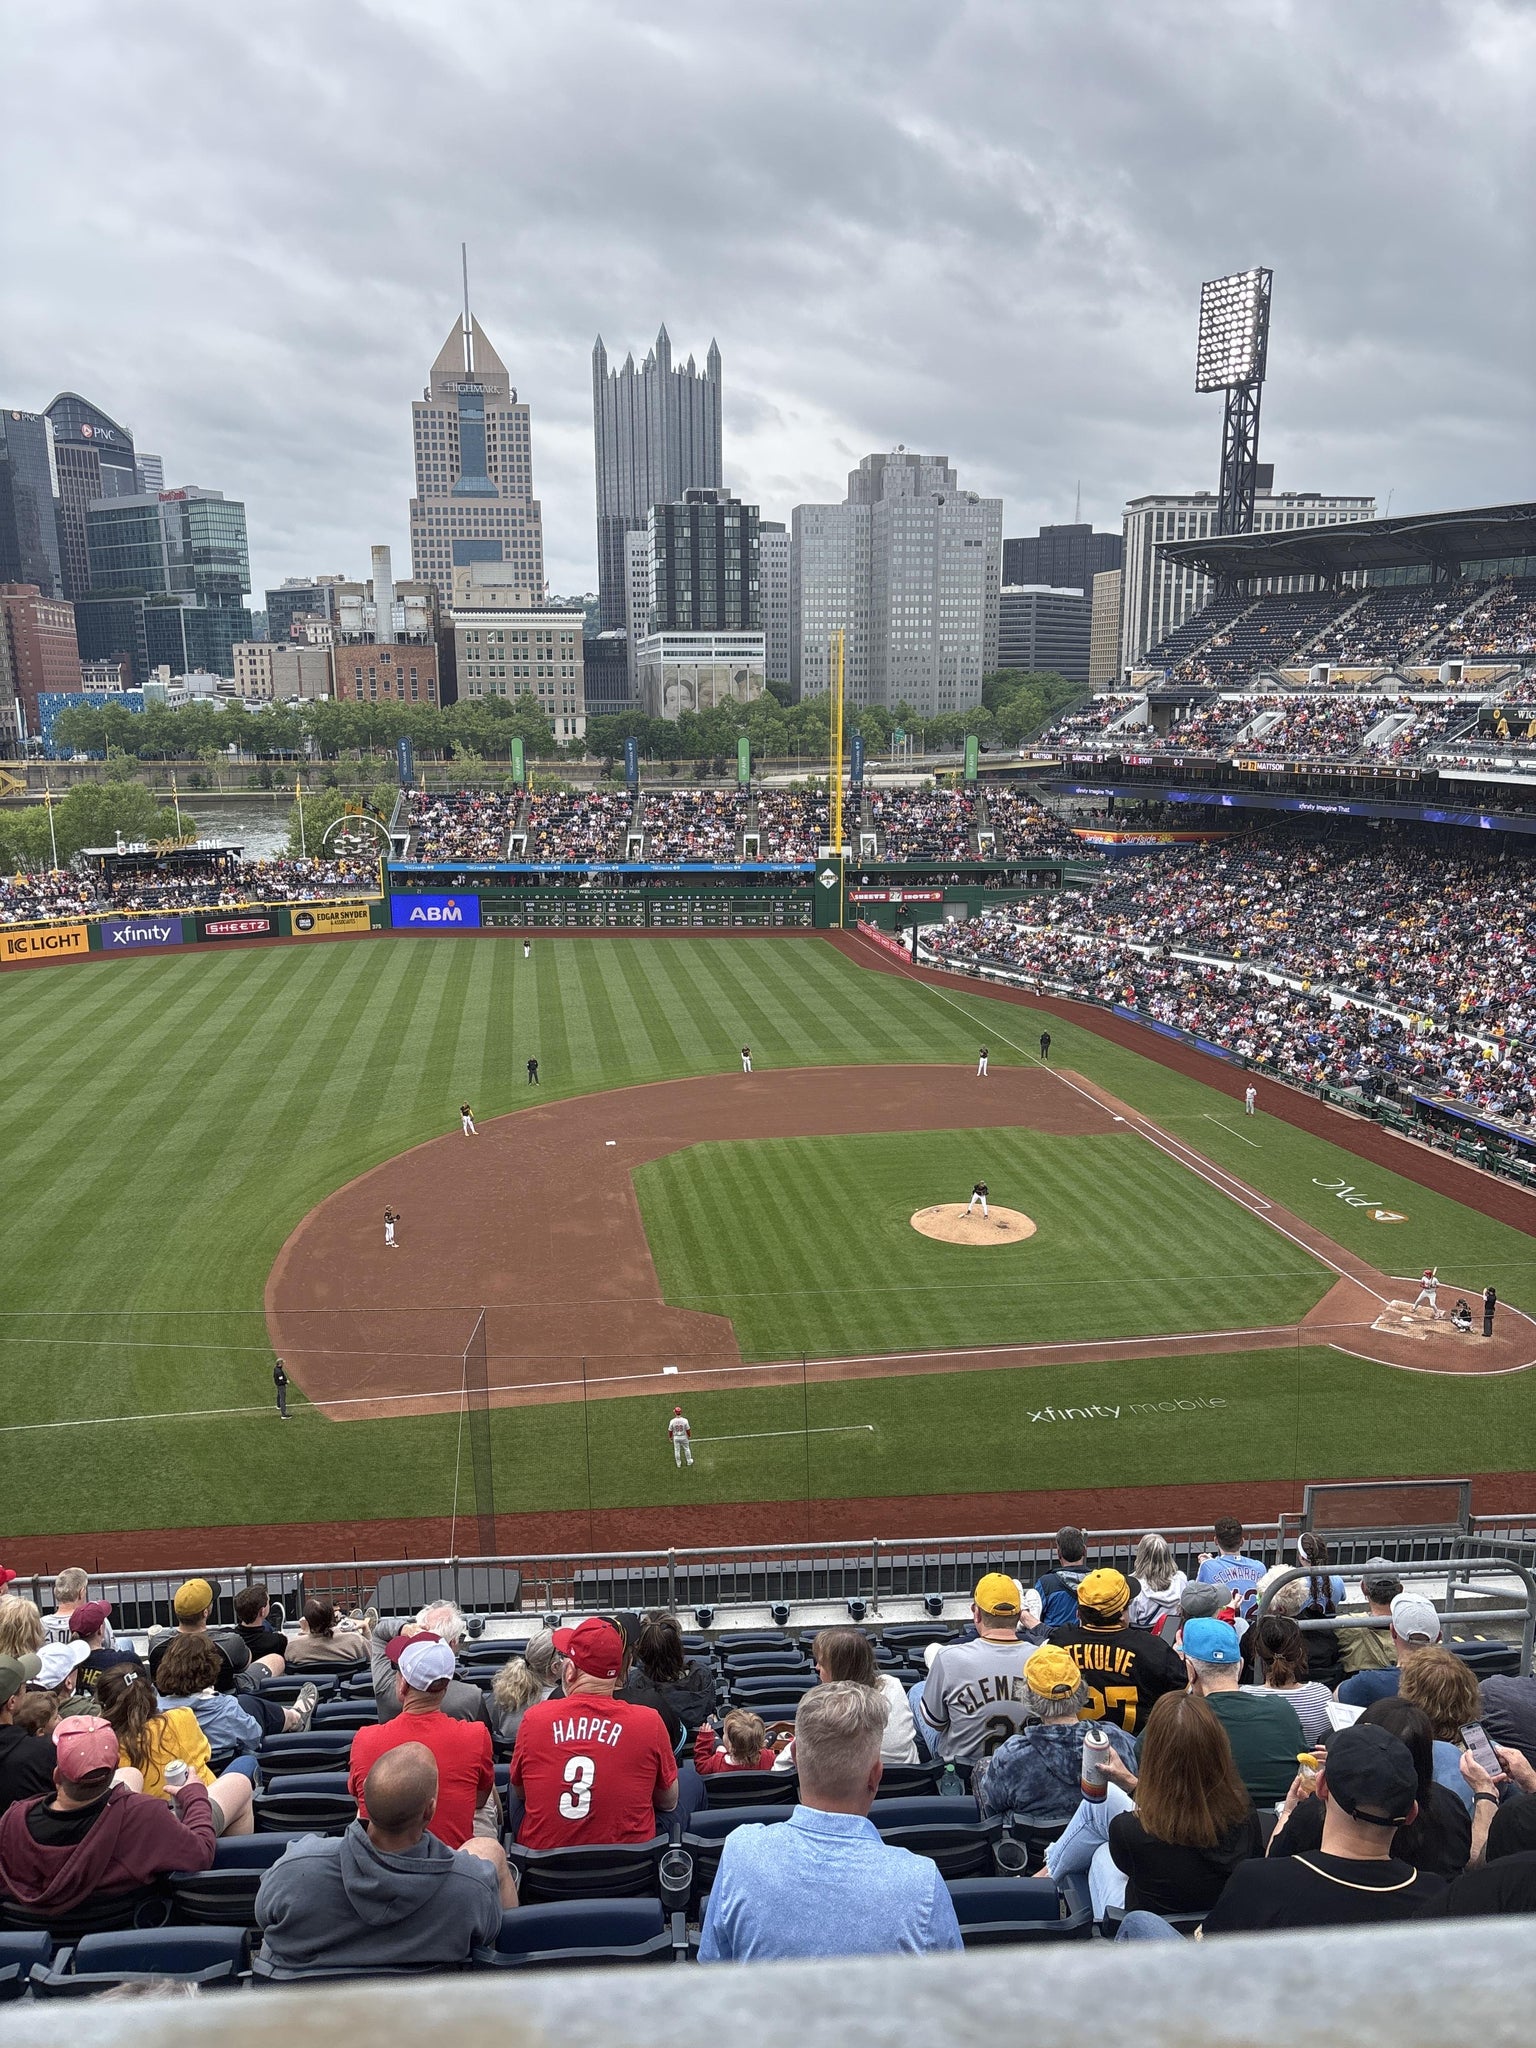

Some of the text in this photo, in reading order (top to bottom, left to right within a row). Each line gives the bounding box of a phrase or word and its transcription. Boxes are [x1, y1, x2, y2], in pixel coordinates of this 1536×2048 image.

[447, 382, 500, 394] HIGHMARK
[22, 413, 39, 423] PNC
[93, 428, 116, 441] PNC
[1257, 762, 1285, 771] MATTSON
[1316, 804, 1337, 812] Imagine
[196, 840, 222, 850] TIME
[1121, 833, 1156, 844] Surfside
[317, 912, 339, 920] EDGAR
[340, 910, 368, 919] SNYDER
[410, 906, 462, 921] ABM
[113, 925, 172, 944] xfinity
[210, 922, 265, 932] SHEETZ
[8, 934, 81, 954] IC LIGHT
[1312, 1177, 1383, 1208] PNC
[1026, 1397, 1227, 1422] xfinity mobile
[1213, 1567, 1261, 1584] SCHWARBE
[1064, 1643, 1136, 1678] TEKULVE
[957, 1675, 1024, 1714] CLEME
[1076, 1686, 1138, 1734] 27
[552, 1716, 623, 1747] HARPER
[558, 1755, 596, 1820] 3
